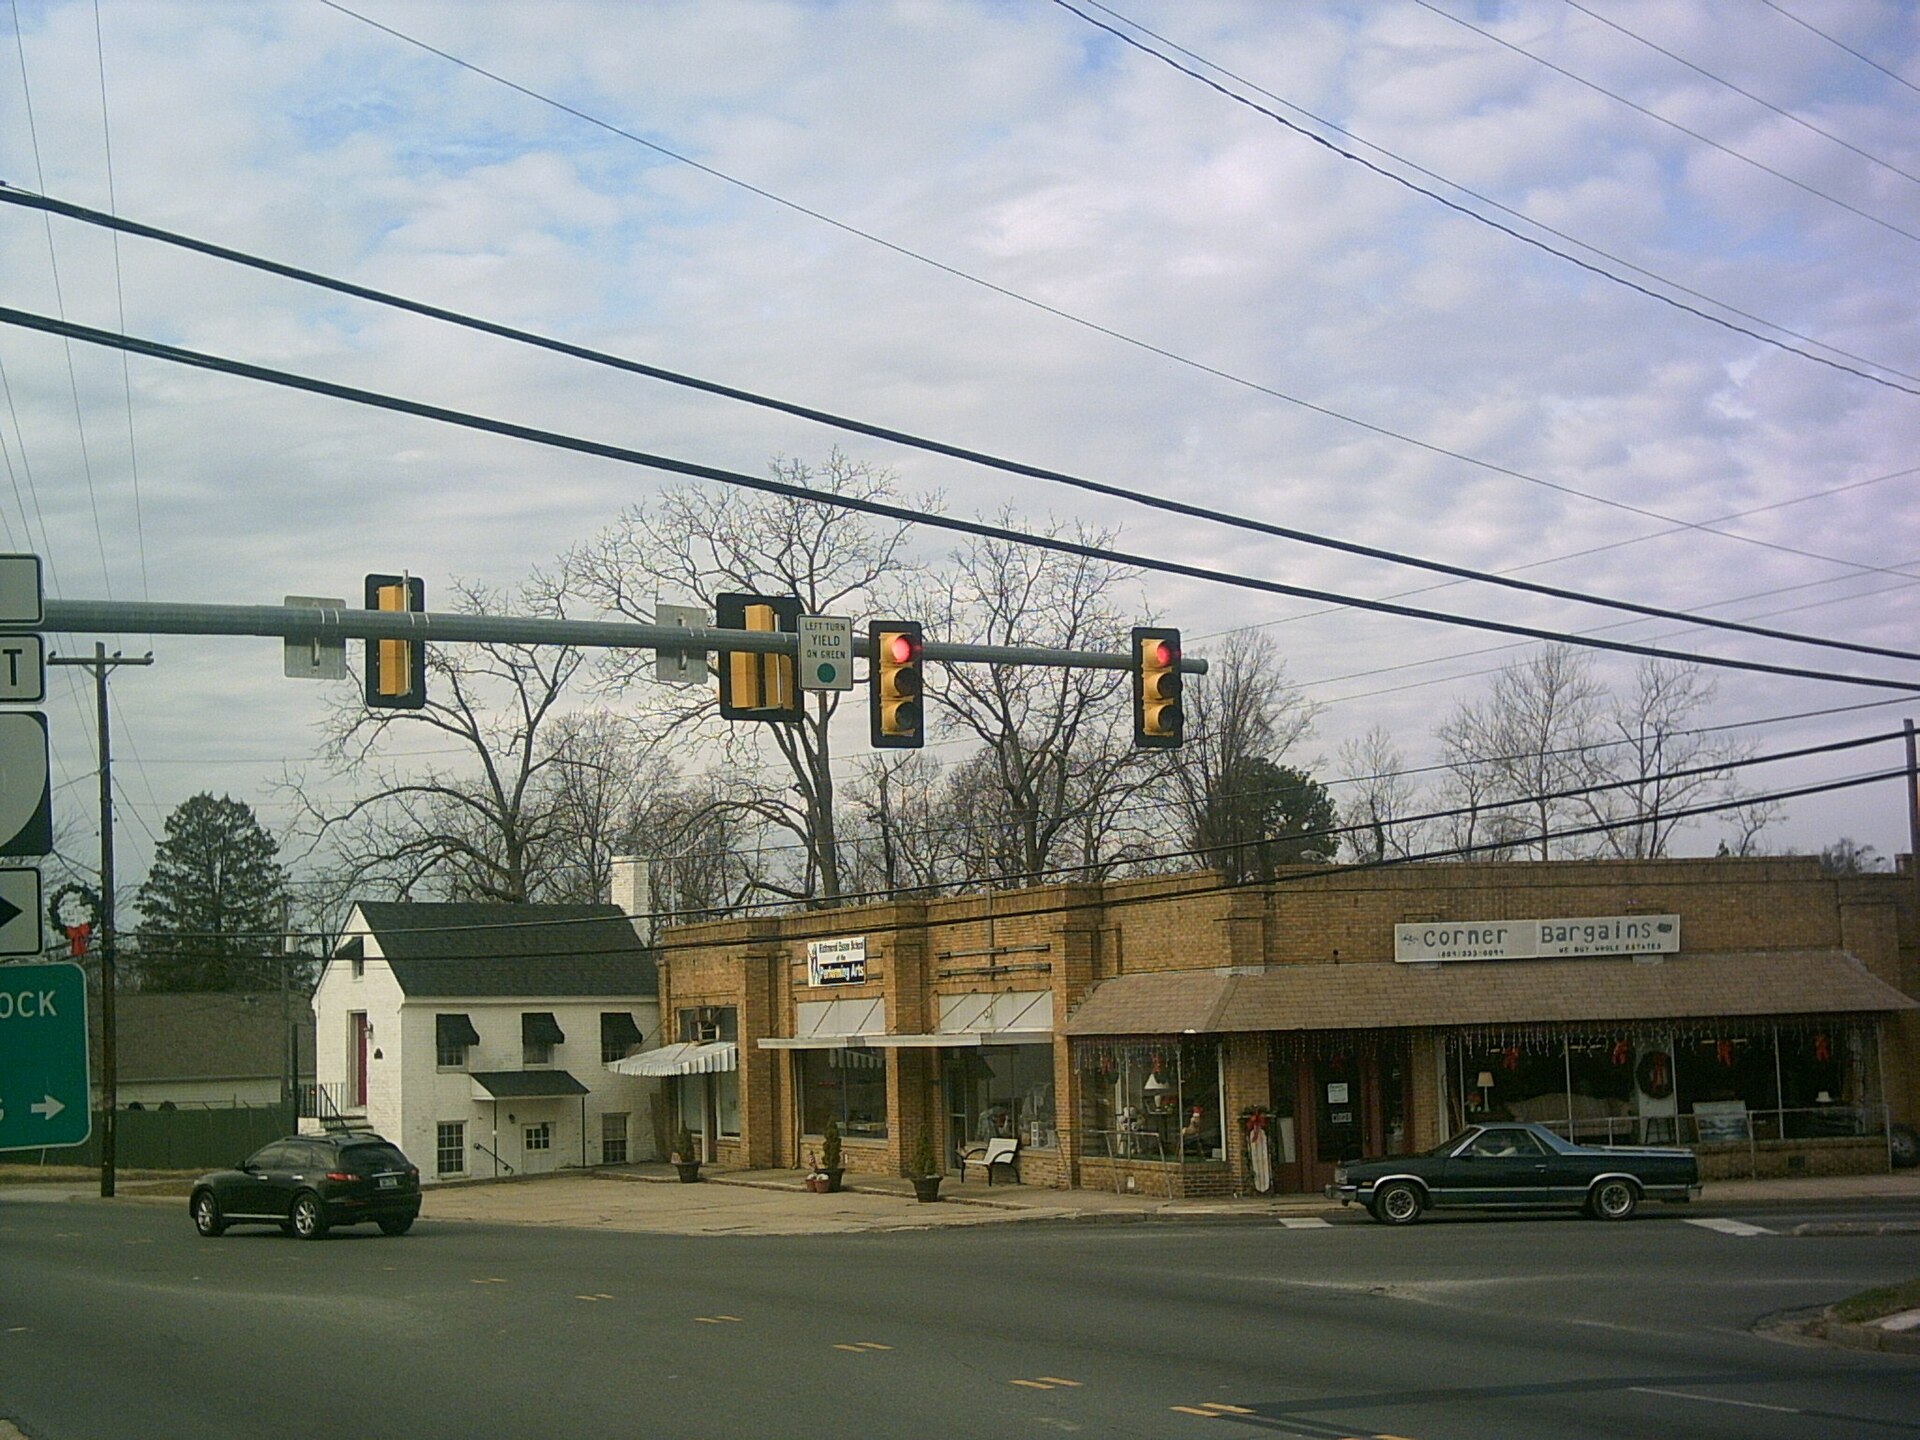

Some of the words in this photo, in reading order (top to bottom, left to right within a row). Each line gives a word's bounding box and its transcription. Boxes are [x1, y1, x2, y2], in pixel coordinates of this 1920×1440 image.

[805, 622, 822, 631] LEFT
[826, 622, 845, 631] TURN
[812, 635, 840, 646] YIELD
[807, 649, 817, 658] ON
[821, 650, 845, 659] GREEN
[1423, 928, 1508, 947] Corner
[1541, 921, 1651, 943] Bargains
[1595, 944, 1619, 952] WHOLE
[1625, 943, 1661, 951] ESTATES
[851, 963, 864, 977] Arts
